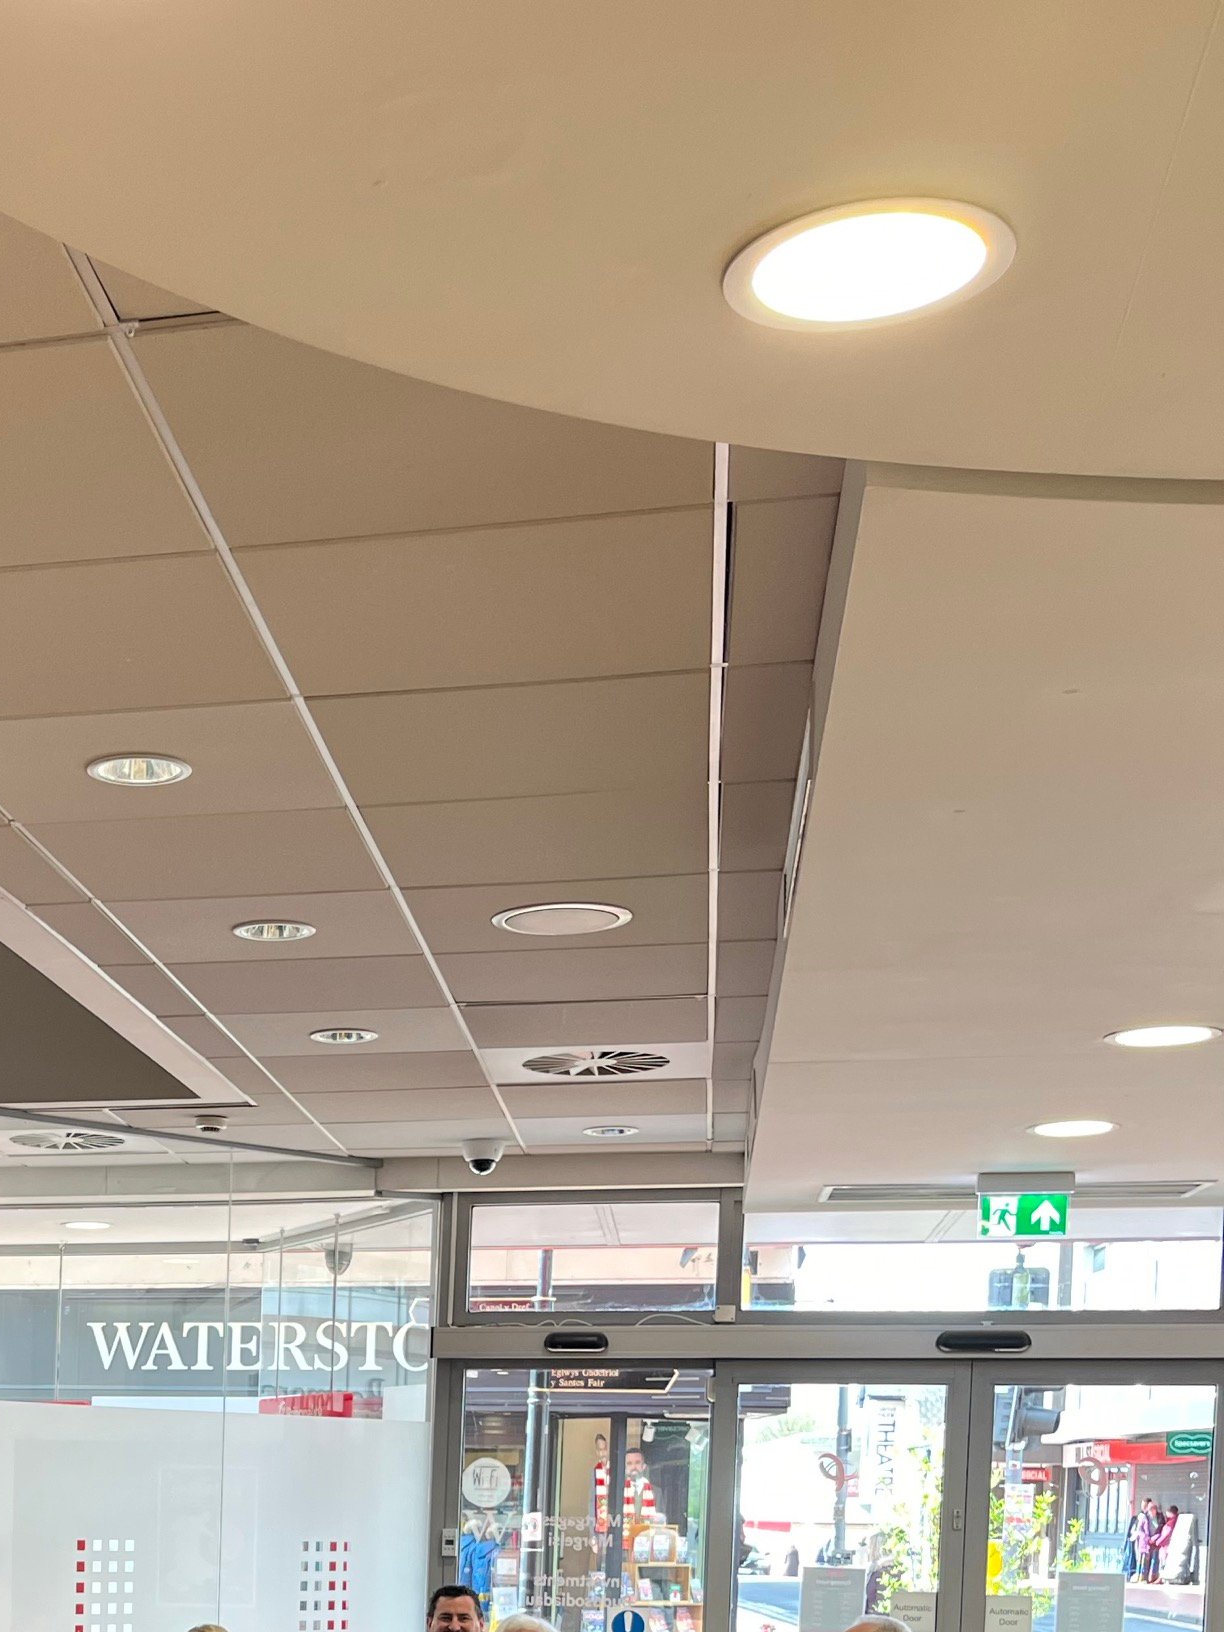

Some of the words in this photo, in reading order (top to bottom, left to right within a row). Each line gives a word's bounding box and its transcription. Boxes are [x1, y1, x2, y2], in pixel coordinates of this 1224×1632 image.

[558, 1379, 585, 1387] Santes
[587, 1379, 605, 1387] Fair
[893, 1604, 932, 1612] Automatic
[989, 1607, 1029, 1616] Automatic
[998, 1618, 1018, 1626] Door
